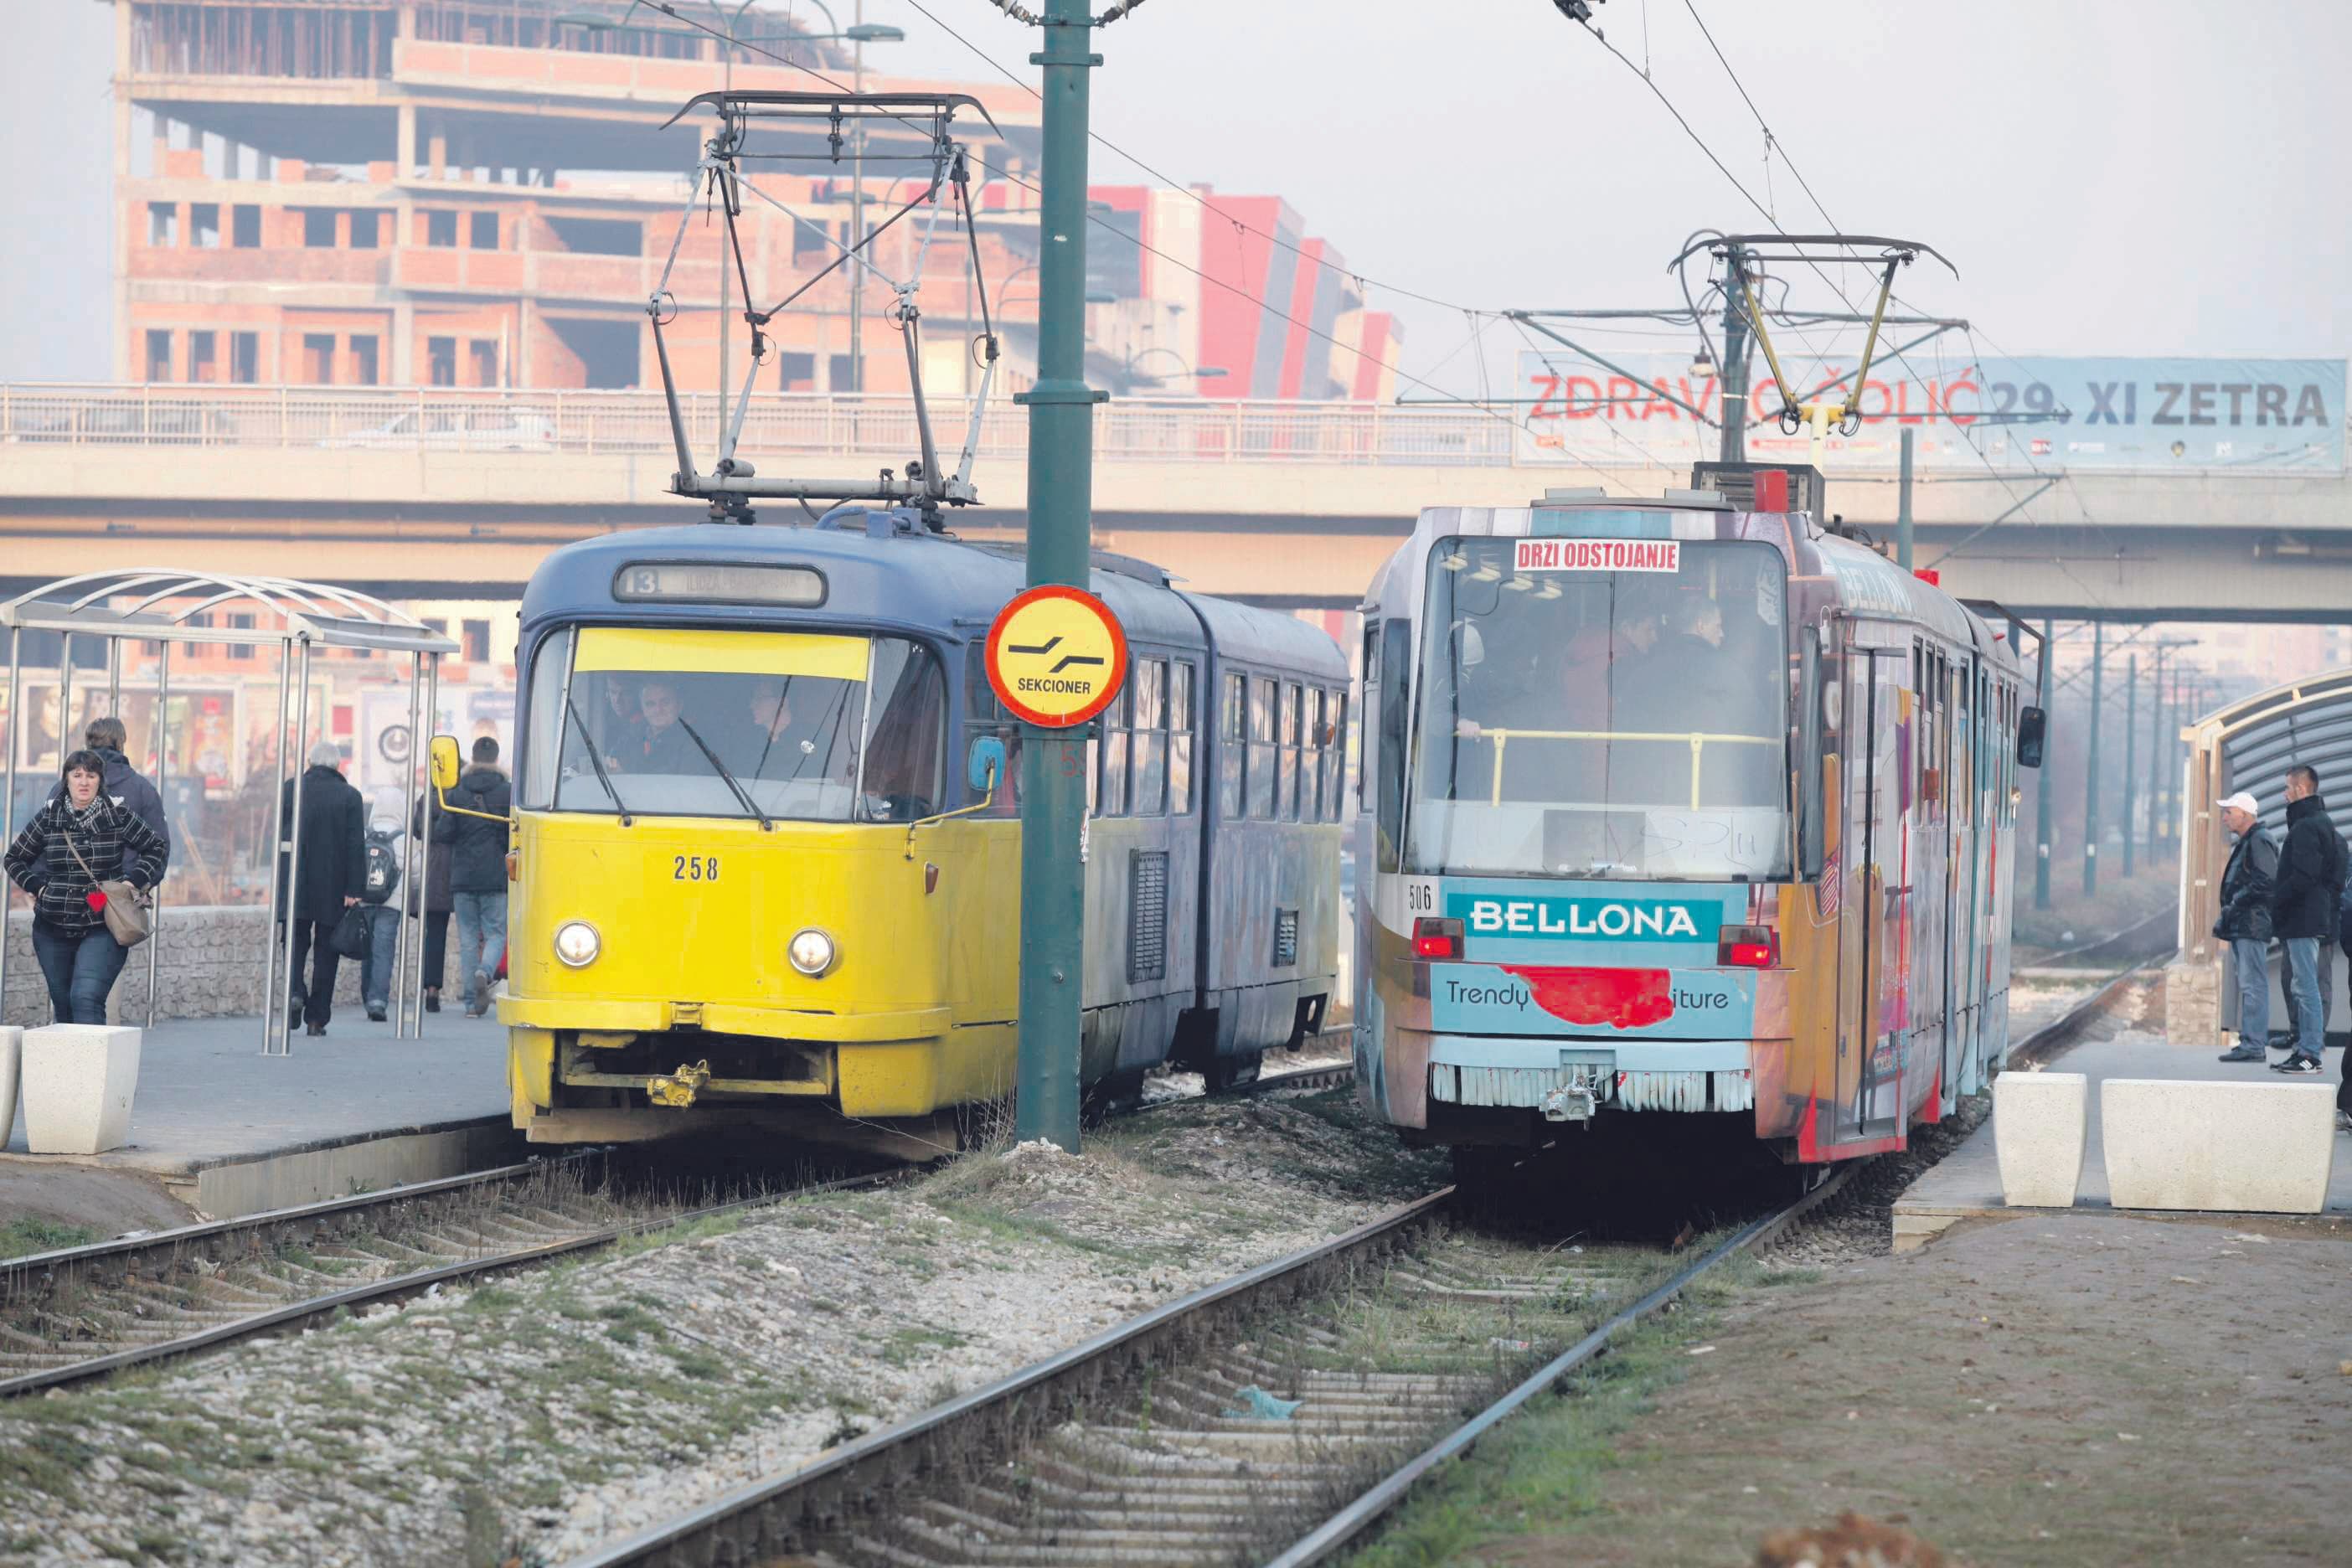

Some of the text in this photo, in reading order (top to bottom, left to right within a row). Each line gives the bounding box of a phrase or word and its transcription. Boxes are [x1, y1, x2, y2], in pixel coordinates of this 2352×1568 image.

[1529, 375, 1792, 423] ZDRAVO
[2085, 381, 2137, 425] XI
[2151, 383, 2329, 427] ZETRA
[1517, 541, 1676, 569] DRŽI ODSTOJANJE
[1018, 678, 1091, 694] SEKCIONER
[673, 855, 718, 880] 258
[1409, 885, 1431, 911] 506
[1470, 900, 1699, 936] BELLONA
[1446, 980, 1729, 1011] Trendy iture
